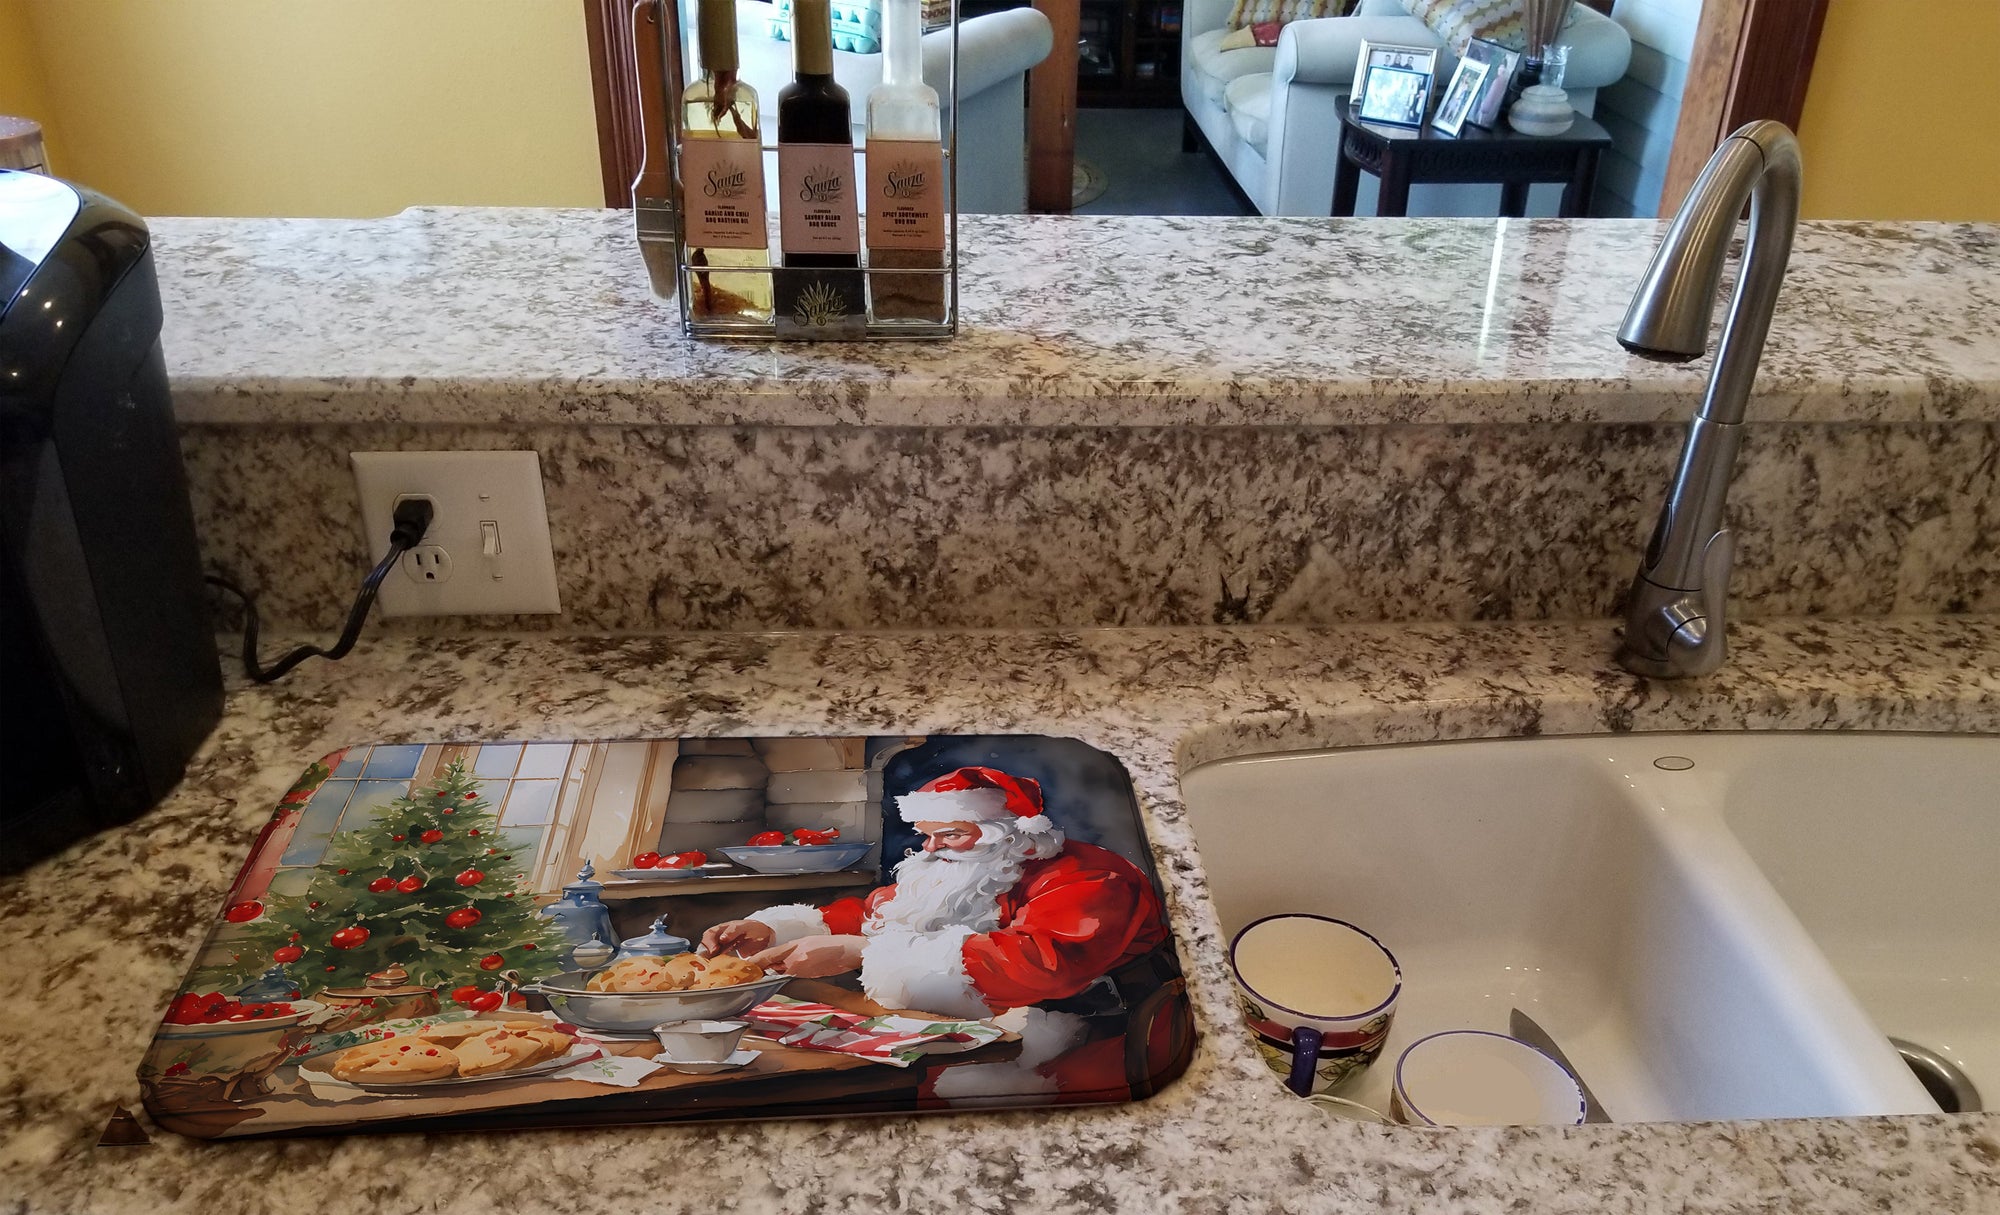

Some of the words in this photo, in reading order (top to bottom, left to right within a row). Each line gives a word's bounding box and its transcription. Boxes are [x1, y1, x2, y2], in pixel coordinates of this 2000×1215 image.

[703, 169, 746, 197] Sauza
[800, 175, 842, 202] Sauza
[883, 171, 926, 198] Sauza
[898, 211, 929, 219] SOUTHWEST
[793, 295, 844, 327] Sauza
